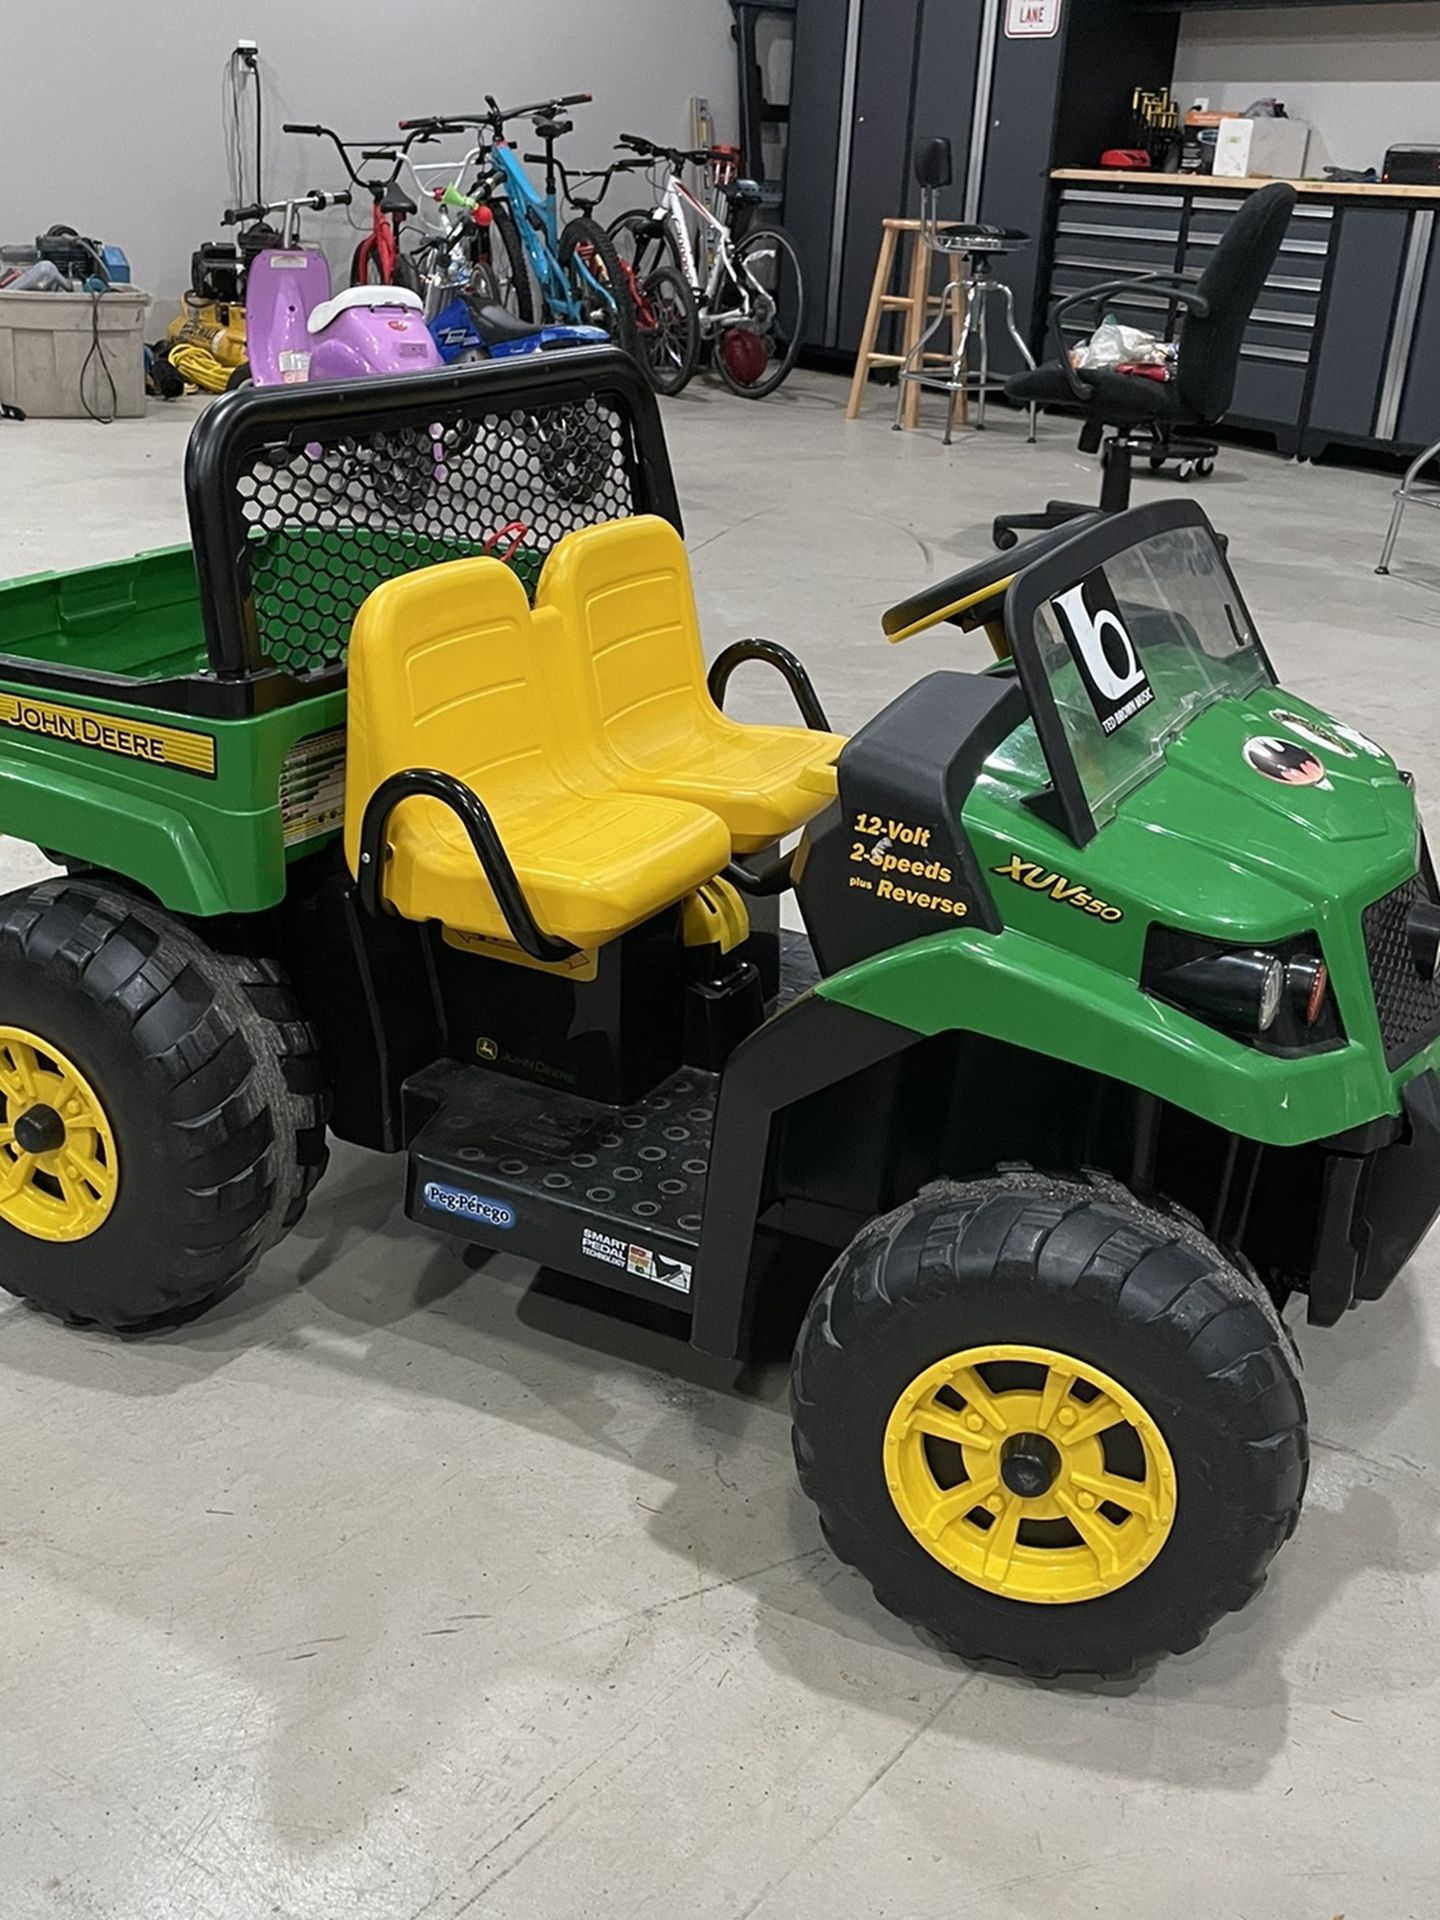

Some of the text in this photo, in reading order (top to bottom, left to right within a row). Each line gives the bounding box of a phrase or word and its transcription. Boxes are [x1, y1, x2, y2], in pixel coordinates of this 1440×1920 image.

[1020, 6, 1044, 23] LANE
[9, 701, 166, 762] JOHN DEERE
[853, 812, 931, 848] 12-Volt
[849, 842, 953, 884] 2-Speeds
[849, 876, 968, 918] plus Reverse
[582, 1228, 628, 1252] SMART
[582, 1237, 627, 1262] PEDAL
